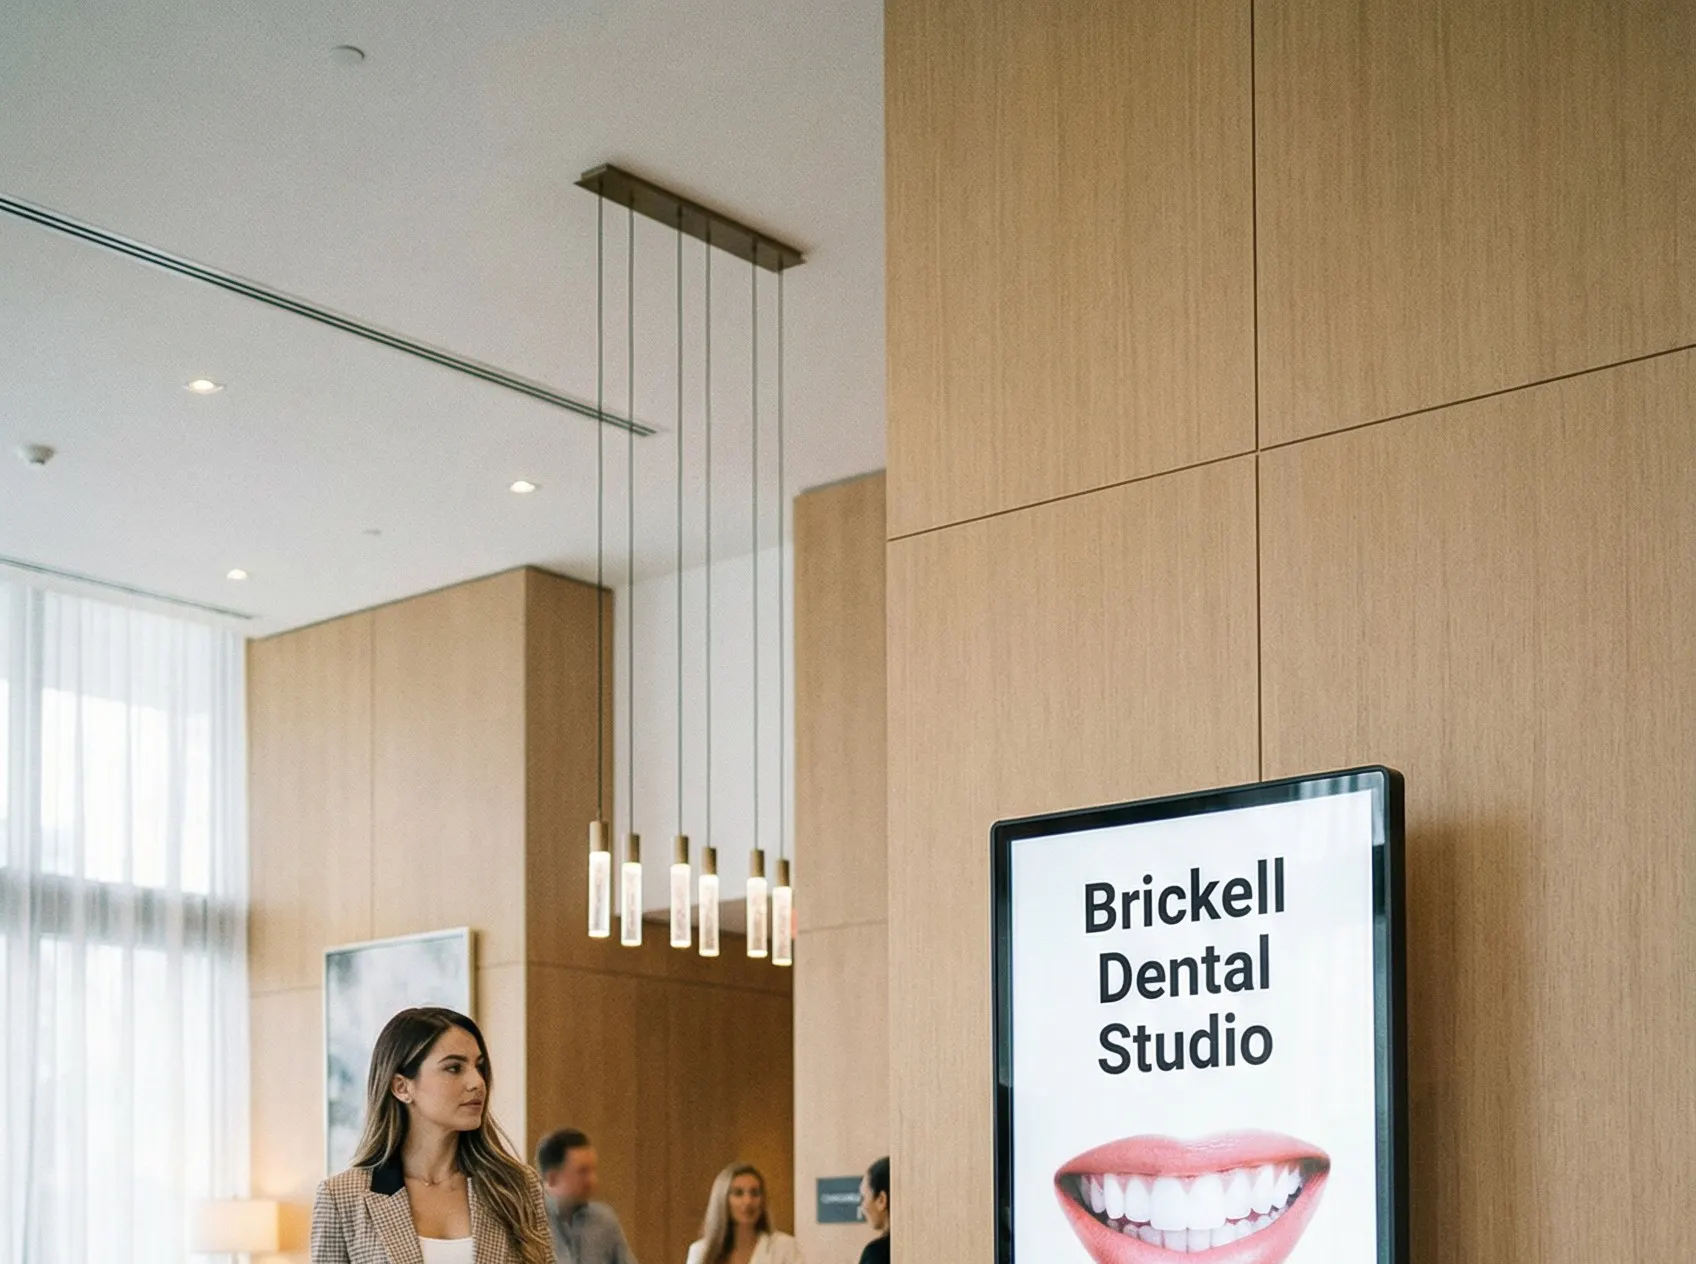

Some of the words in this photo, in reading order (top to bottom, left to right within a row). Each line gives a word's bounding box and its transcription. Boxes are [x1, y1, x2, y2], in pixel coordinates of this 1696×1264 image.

[1084, 856, 1285, 934] Brickell
[1099, 934, 1271, 1004] Dental
[1098, 1012, 1273, 1075] Studio
